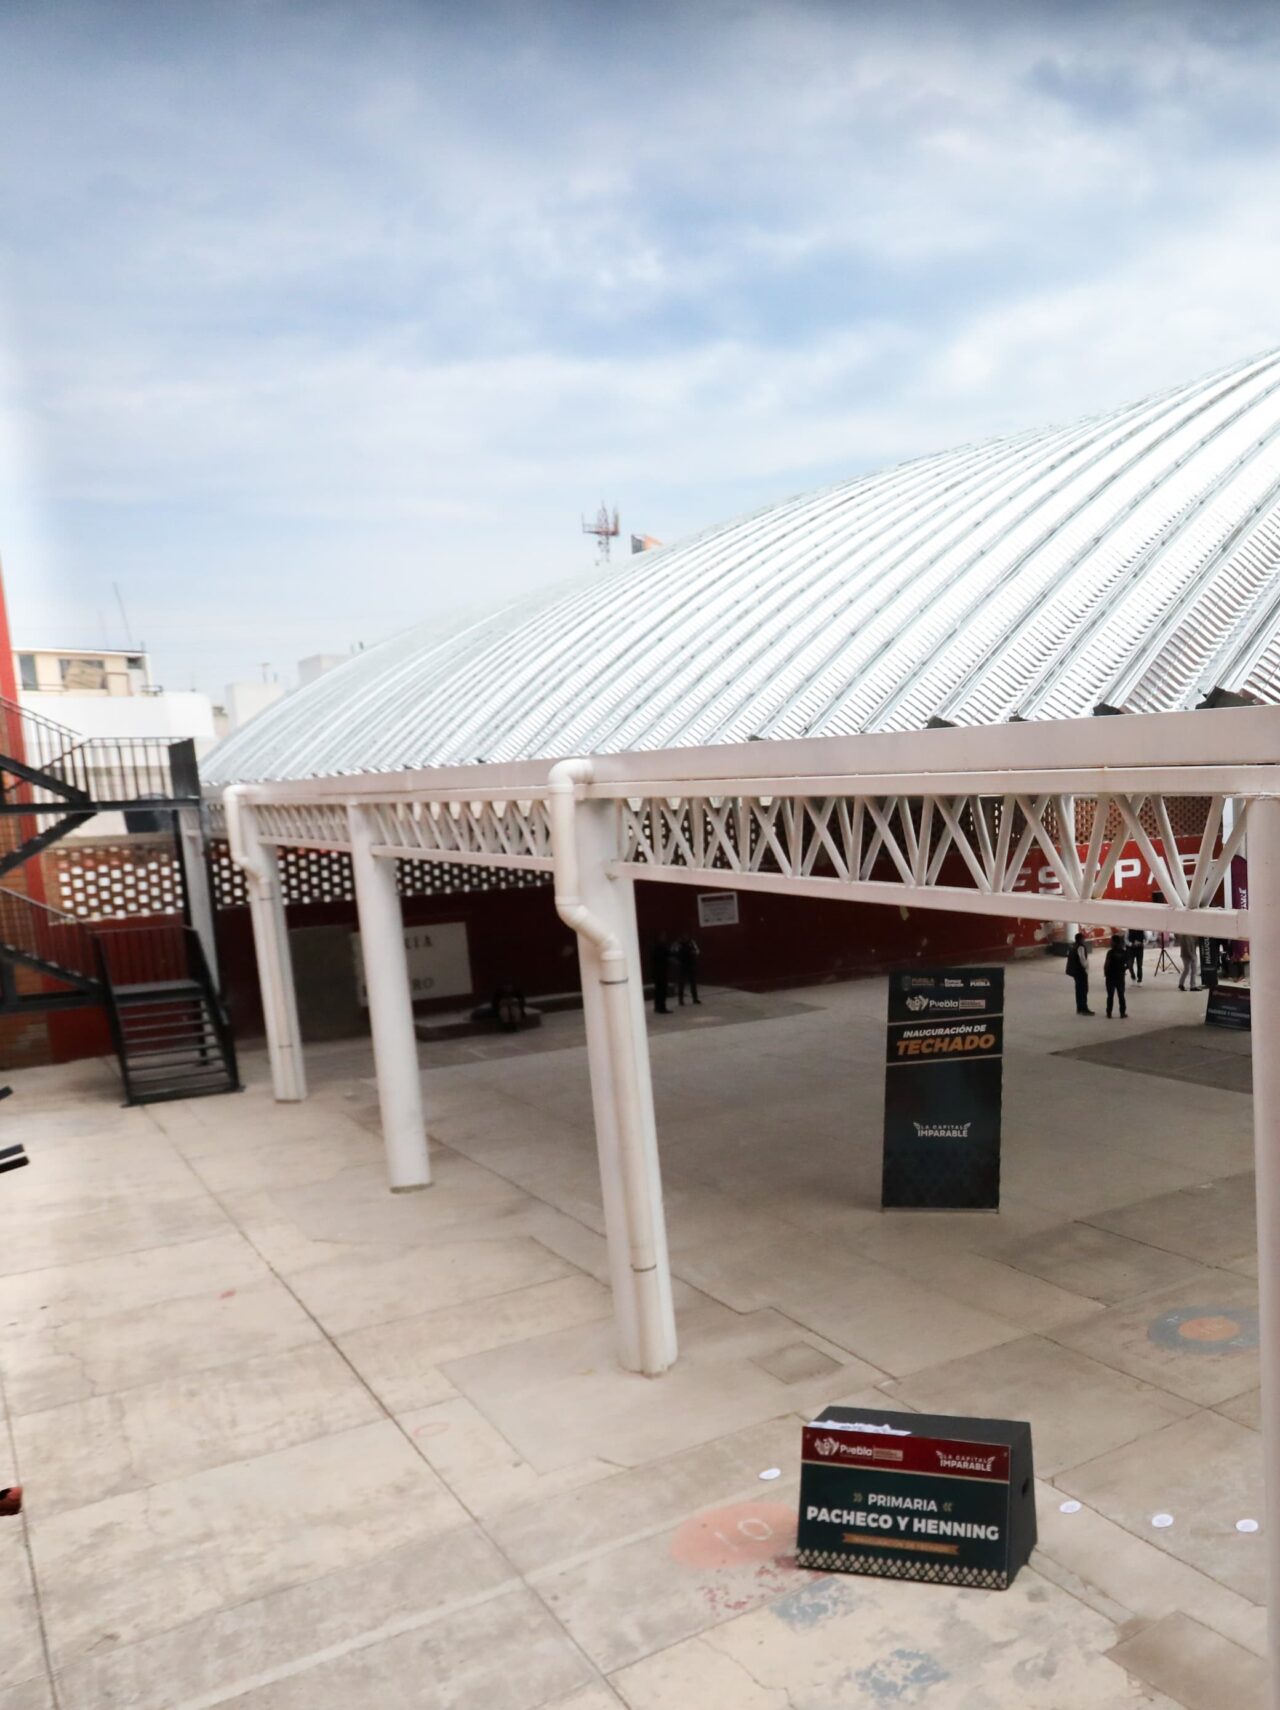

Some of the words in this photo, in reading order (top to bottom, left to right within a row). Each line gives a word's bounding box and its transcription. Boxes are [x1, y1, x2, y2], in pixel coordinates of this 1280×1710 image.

[929, 1000, 959, 1008] Puebla
[903, 1025, 972, 1038] INAUGURACIÓN
[973, 1024, 987, 1032] DE
[896, 1034, 996, 1055] TECHADO
[917, 1129, 969, 1137] IMPARABLE
[840, 1445, 873, 1457] Puebla
[940, 1459, 992, 1472] IMPARABLE
[955, 1455, 988, 1463] CAPITAL
[868, 1493, 938, 1512] PRIMARIA
[806, 1506, 893, 1529] PACHECO
[896, 1516, 910, 1531] Y
[913, 1518, 1000, 1541] HENNING
